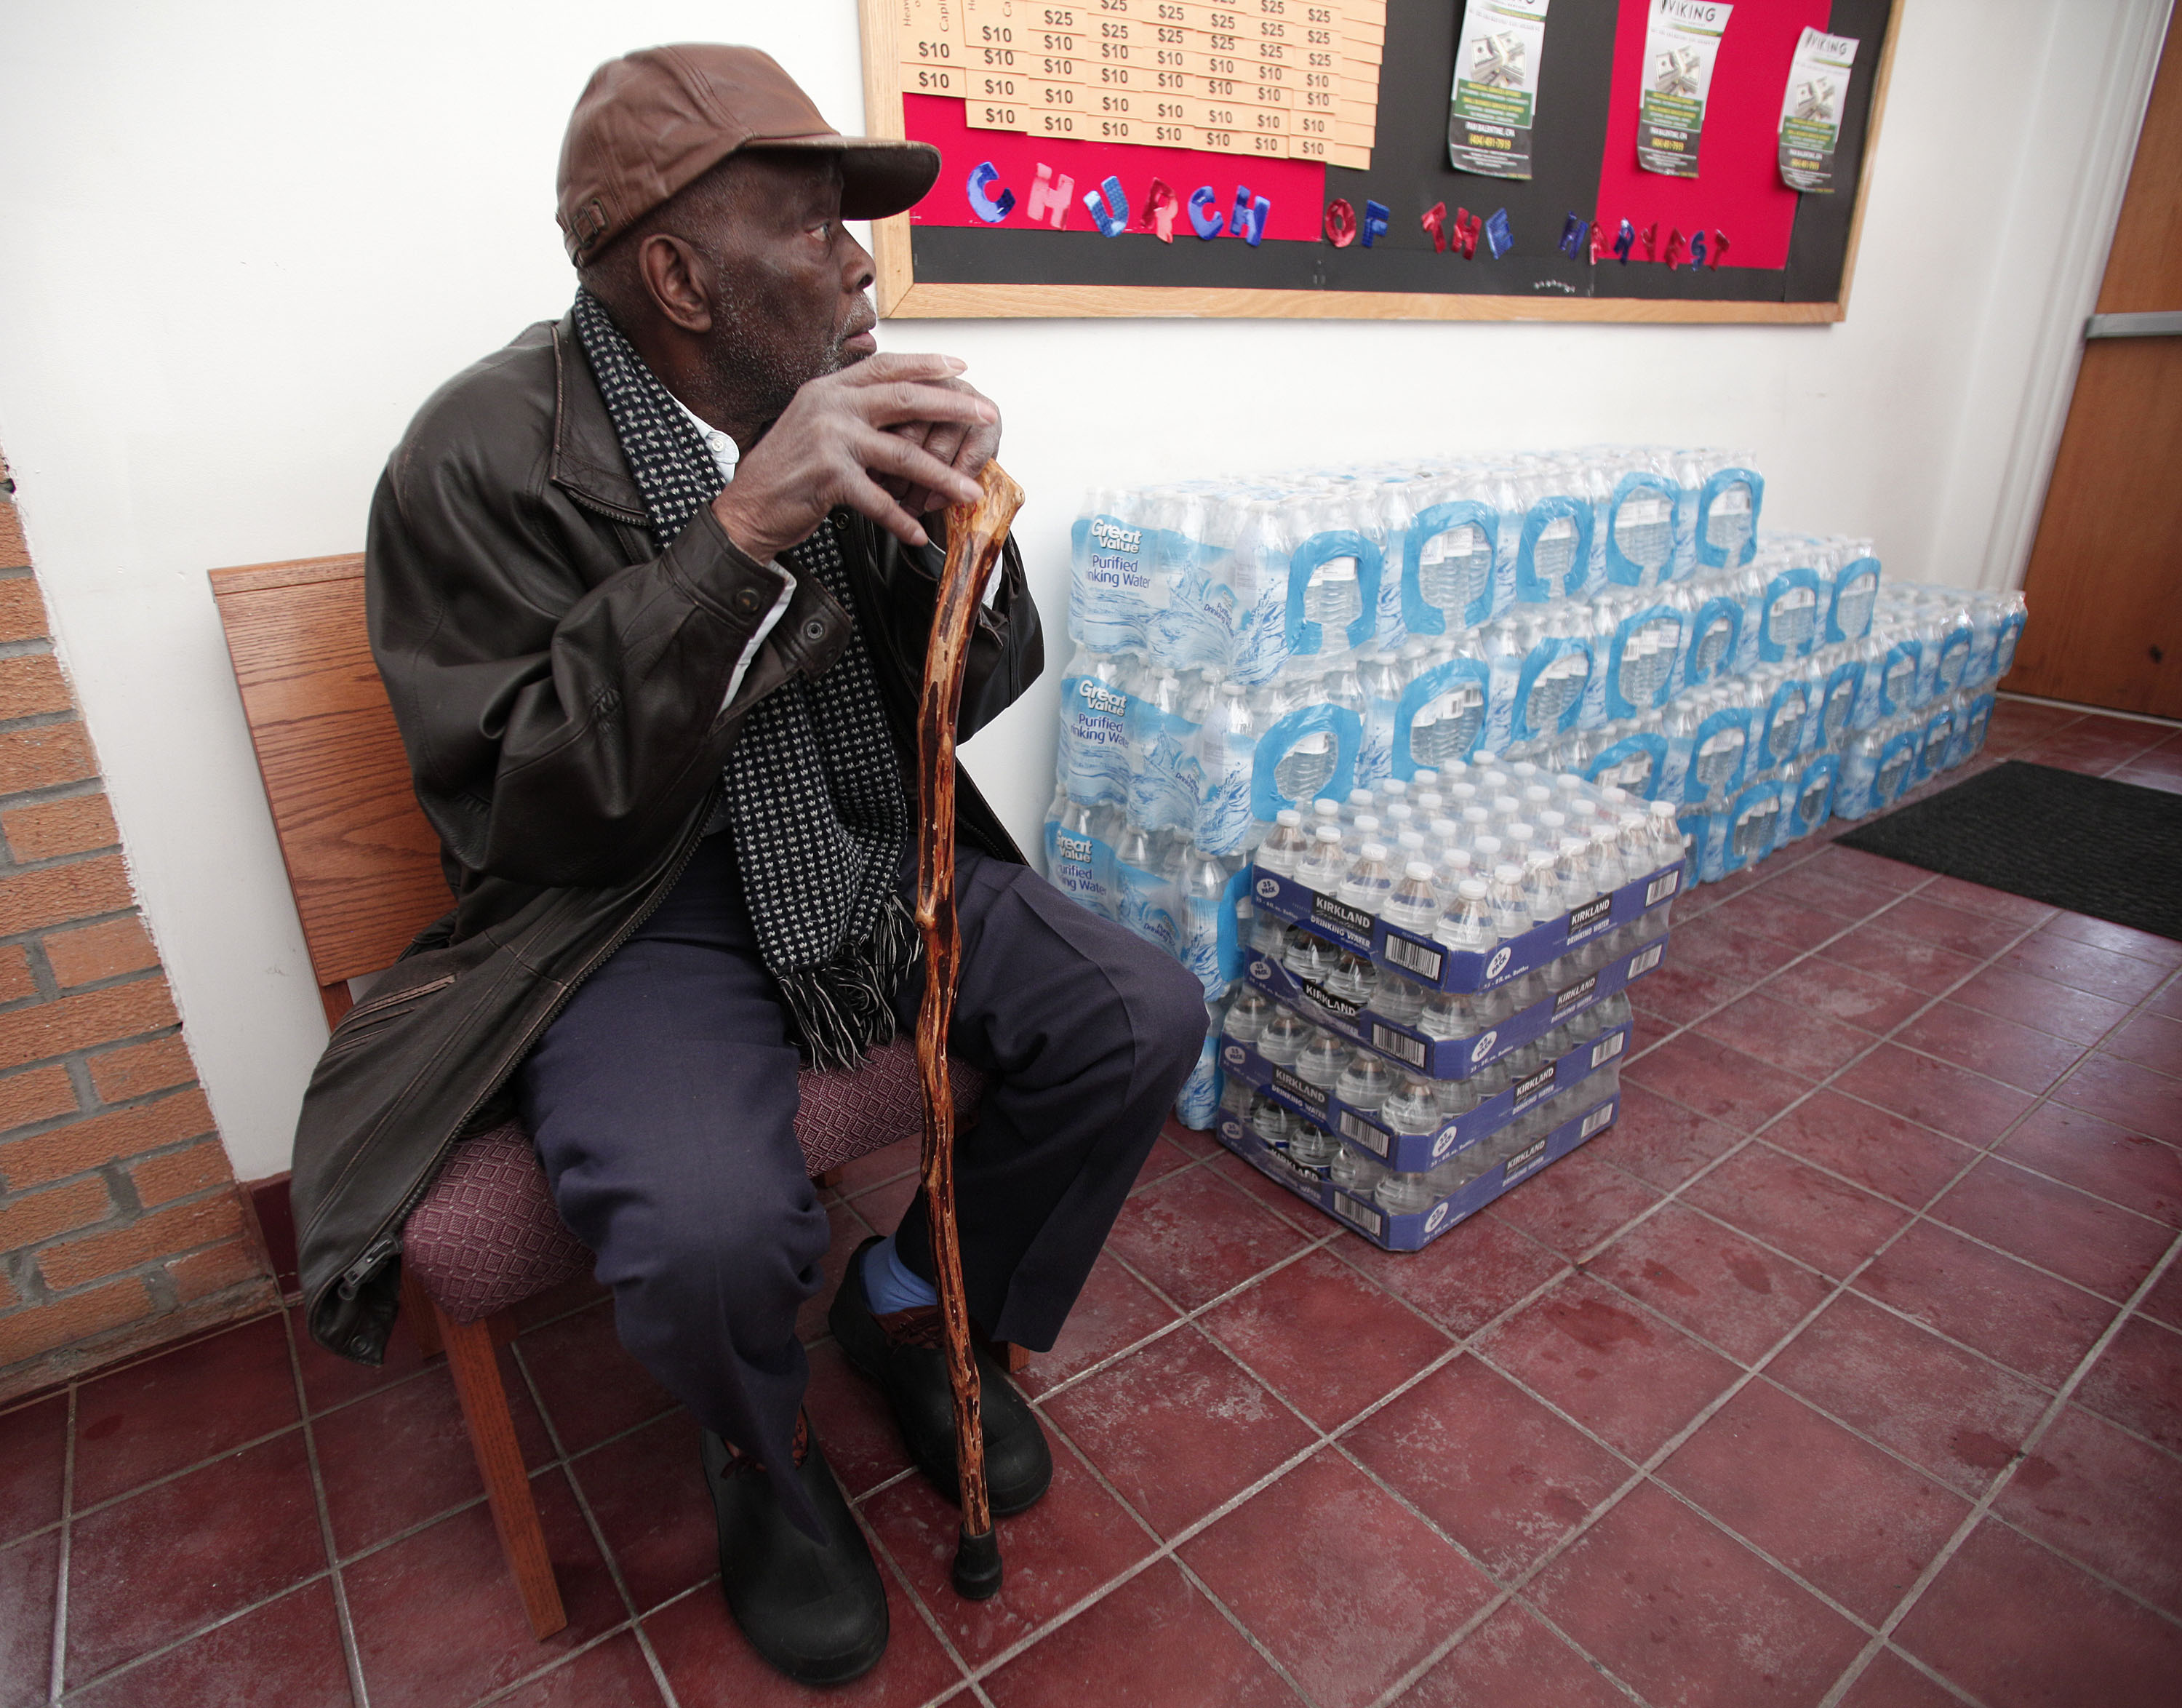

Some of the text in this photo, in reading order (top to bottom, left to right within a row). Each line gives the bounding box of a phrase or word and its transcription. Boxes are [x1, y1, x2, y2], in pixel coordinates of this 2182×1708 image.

[1101, 0, 1127, 11] $25
[1159, 4, 1183, 20] $25
[1262, 0, 1284, 14] $25
[1045, 9, 1072, 25] $25
[1212, 14, 1234, 28] $25
[1309, 9, 1330, 23] $25
[983, 25, 1011, 42] $10
[1102, 23, 1127, 39] $25
[1159, 28, 1183, 43] $25
[1262, 22, 1284, 36] $25
[1044, 35, 1072, 50] $10
[1211, 35, 1234, 50] $25
[1308, 30, 1330, 44] $25
[919, 41, 949, 57] $10
[1103, 43, 1128, 58] $10
[1260, 44, 1282, 57] $25
[985, 49, 1014, 65] $10
[1158, 50, 1183, 65] $10
[1310, 53, 1330, 65] $25
[1044, 58, 1071, 73] $10
[1210, 58, 1233, 73] $10
[1260, 66, 1281, 80] $10
[919, 71, 948, 88] $10
[1102, 68, 1127, 83] $10
[1159, 71, 1183, 86] $10
[1308, 73, 1328, 87] $10
[986, 79, 1013, 95] $10
[1209, 80, 1232, 95] $10
[1259, 87, 1280, 100] $10
[1046, 88, 1073, 103] $10
[1308, 92, 1329, 105] $10
[1103, 97, 1128, 111] $10
[1159, 103, 1183, 117] $10
[986, 108, 1015, 123] $10
[1210, 110, 1232, 123] $10
[1258, 114, 1279, 128] $10
[1045, 116, 1072, 131] $10
[1103, 122, 1128, 136] $10
[1304, 119, 1324, 132] $10
[1157, 127, 1181, 140] $10
[1207, 132, 1229, 145] $10
[1256, 137, 1276, 150] $10
[1303, 141, 1323, 154] $10
[967, 161, 1271, 247] CHURCH
[1324, 198, 1390, 248] OF
[1421, 201, 1514, 260] THE
[1091, 519, 1143, 544] Great
[1098, 535, 1140, 554] Value
[1092, 554, 1138, 572] Purified
[1122, 573, 1151, 588] Water
[1079, 680, 1127, 709] Great
[1087, 698, 1125, 717] Value
[1079, 713, 1124, 733] Purified
[1059, 847, 1091, 863] Value
[1261, 887, 1276, 895] PACK
[1316, 896, 1370, 928] KIRKLAND
[1572, 899, 1610, 925] KIRKLAND
[1311, 915, 1345, 936] DRINKING
[1347, 931, 1371, 948] WATER
[1567, 927, 1593, 946] DRINKING
[1594, 918, 1610, 933] WATER
[1492, 954, 1507, 975] PACK
[1494, 953, 1502, 965] 35
[1557, 977, 1596, 1005] KIRKLAND
[1306, 984, 1356, 1016] KIRKLAND
[1477, 1038, 1492, 1058] PACK
[1276, 1069, 1325, 1103] KIRKLAND
[1516, 1067, 1554, 1097] KIRKLAND
[1271, 1085, 1303, 1106] DRINKING
[1306, 1102, 1327, 1120] WATER
[1507, 1140, 1545, 1170] KIRKLAND
